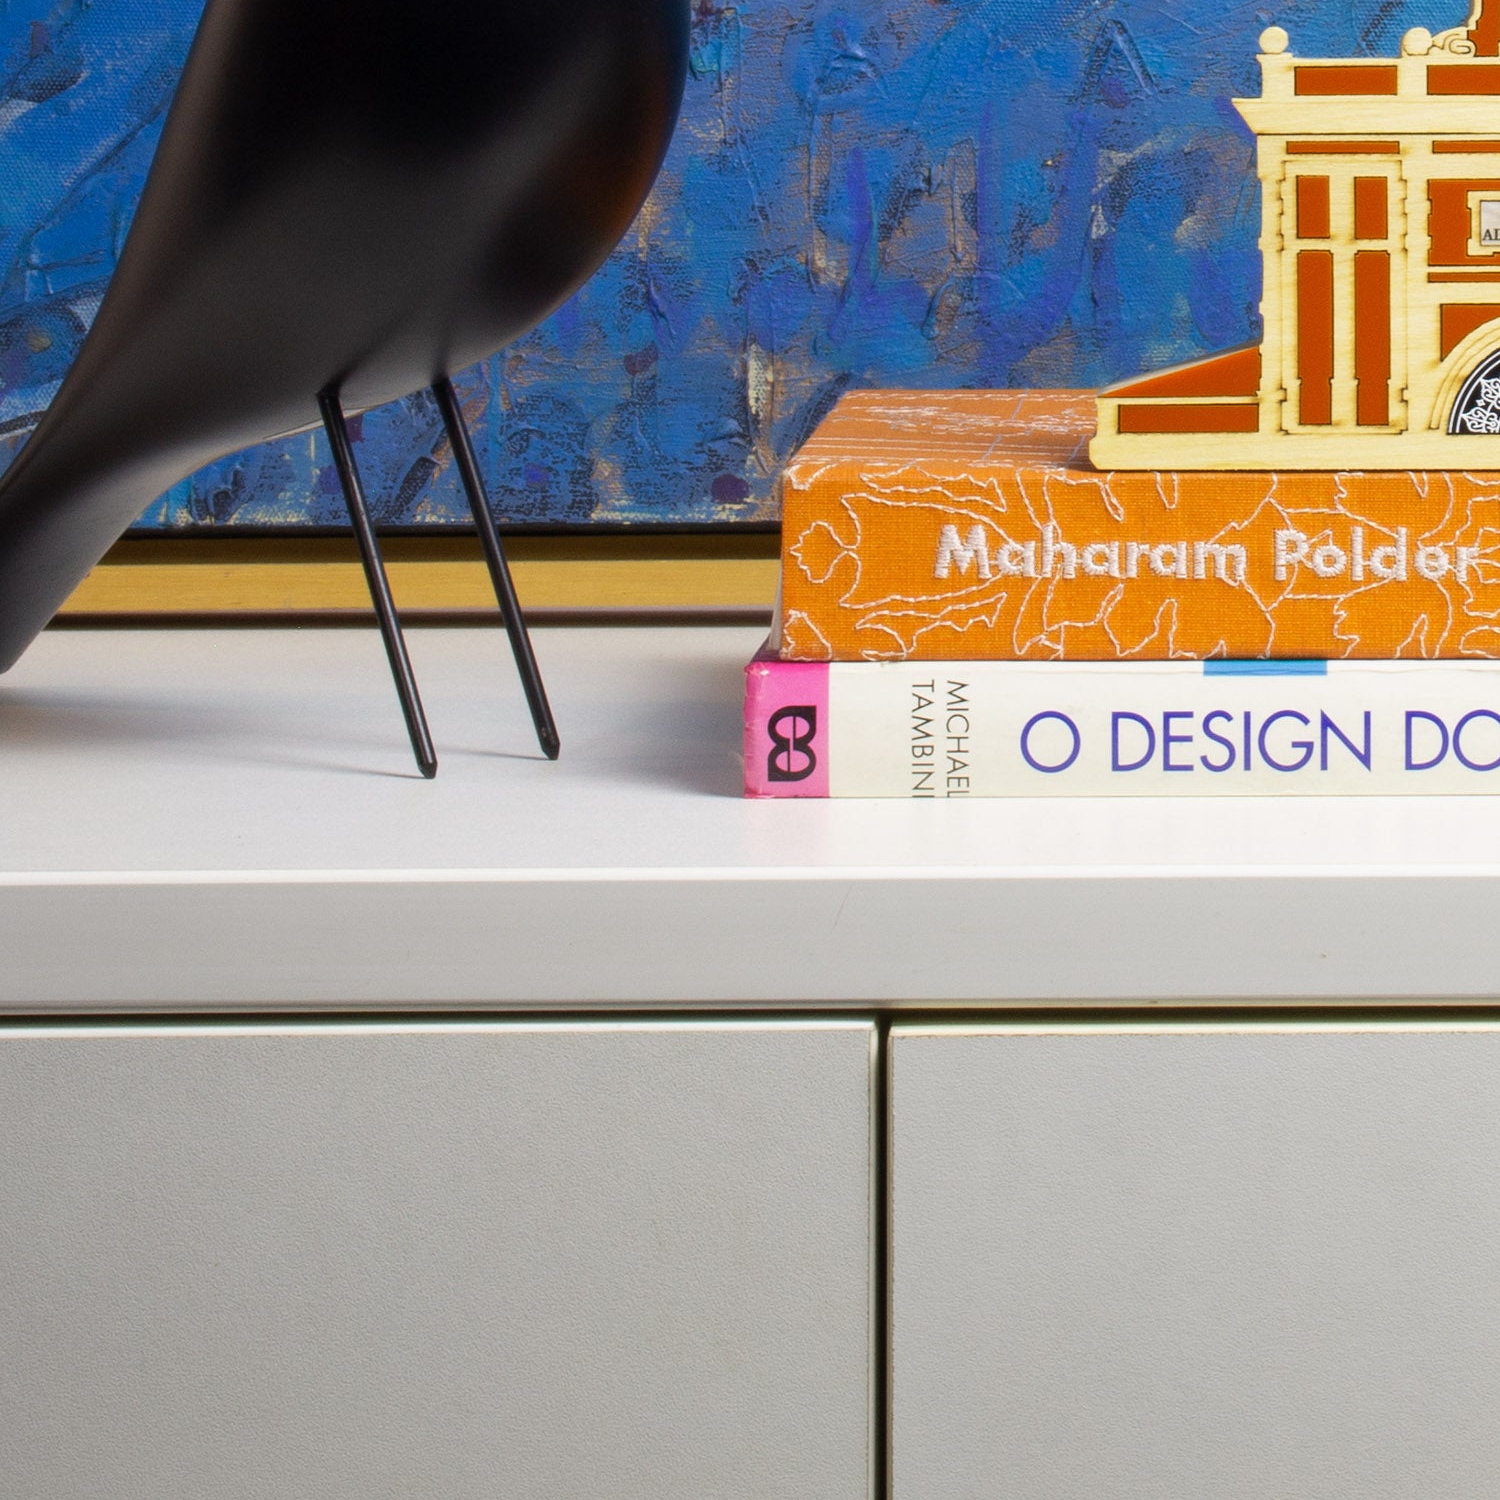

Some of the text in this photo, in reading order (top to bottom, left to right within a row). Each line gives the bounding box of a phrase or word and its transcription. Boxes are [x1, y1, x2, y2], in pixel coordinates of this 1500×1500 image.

[934, 523, 1248, 579] Maharam
[1273, 525, 1480, 582] Polder
[911, 679, 935, 798] TAMBINI
[946, 680, 970, 798] MICHAEL
[1020, 710, 1081, 774] O
[1111, 709, 1372, 772] DESIGN
